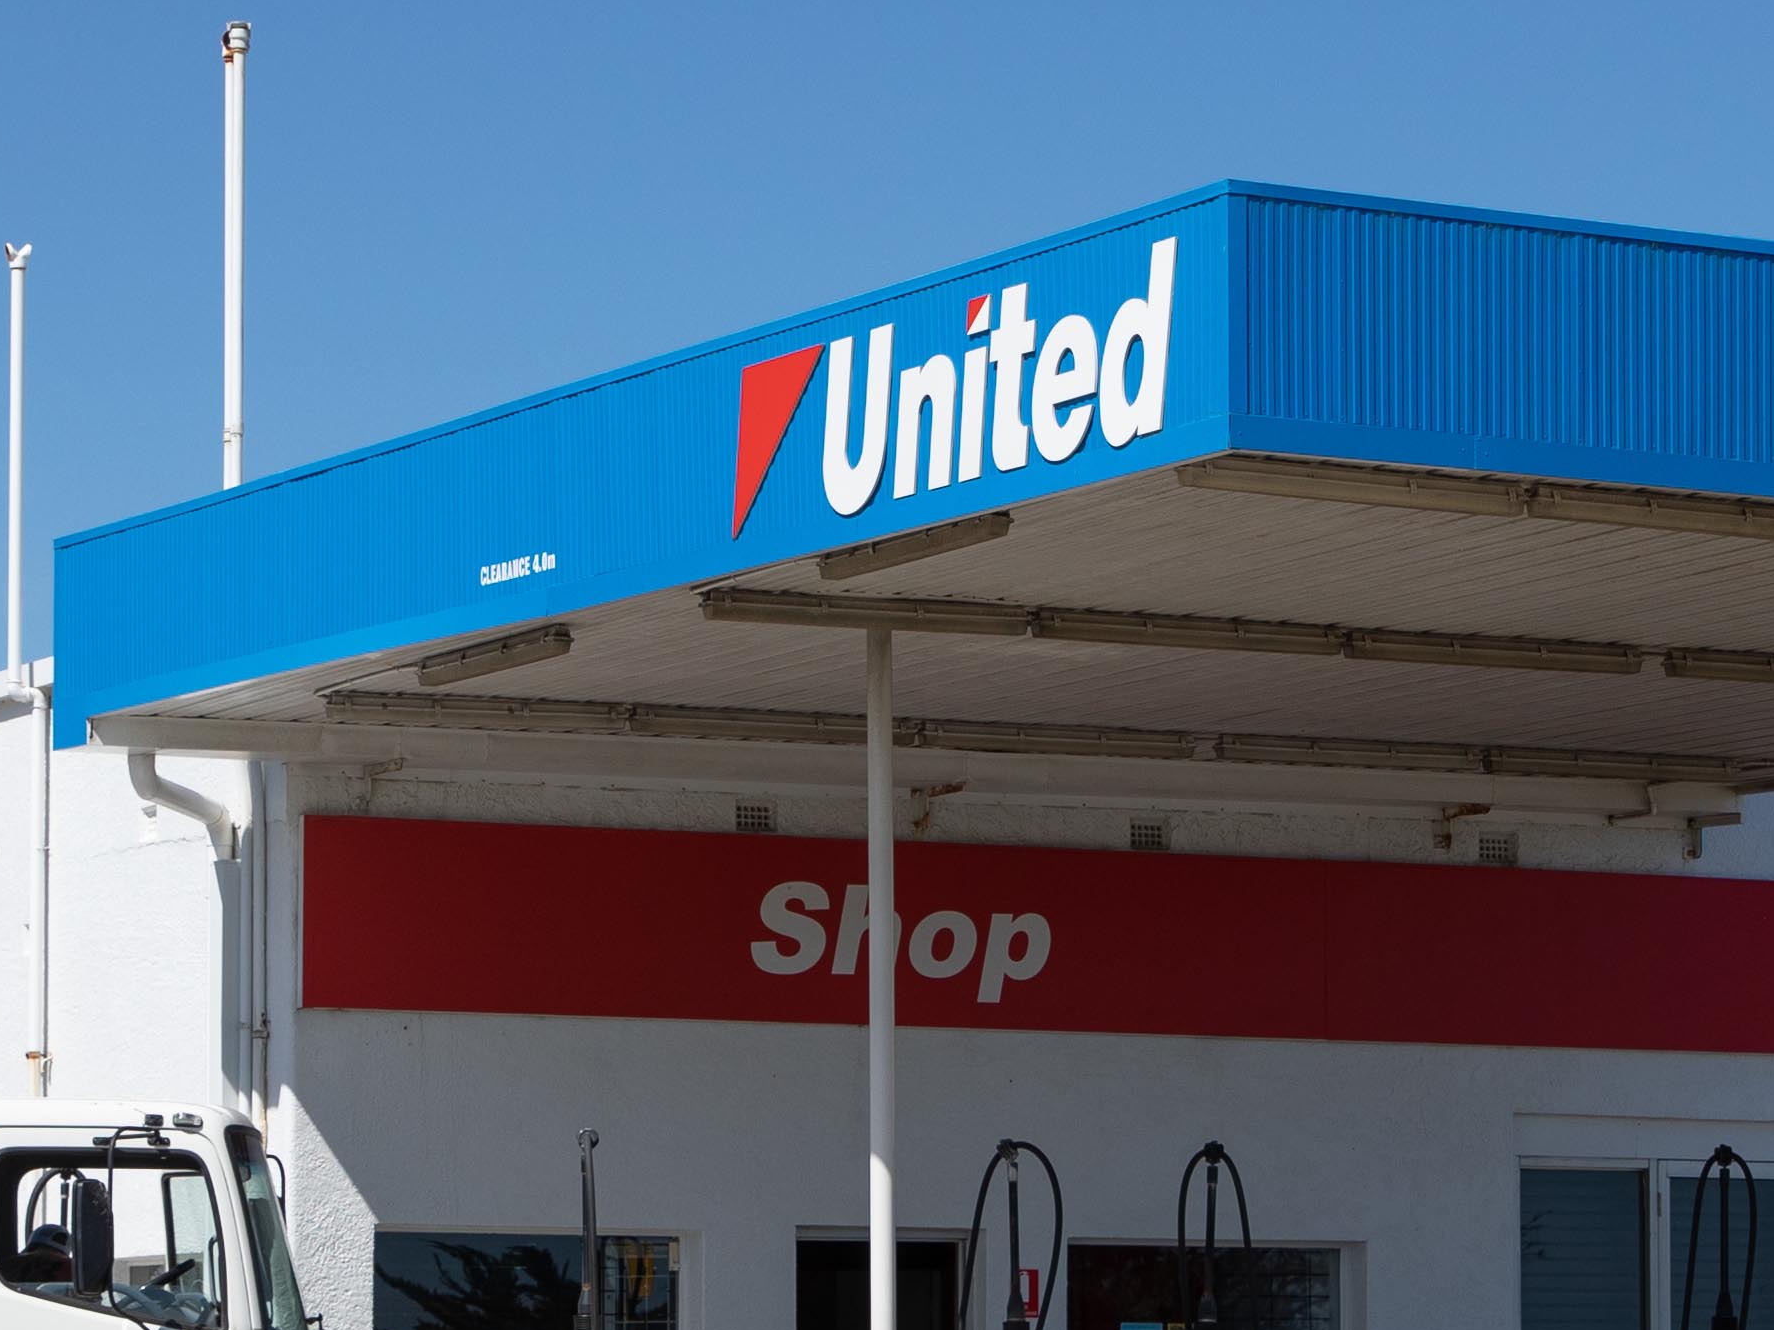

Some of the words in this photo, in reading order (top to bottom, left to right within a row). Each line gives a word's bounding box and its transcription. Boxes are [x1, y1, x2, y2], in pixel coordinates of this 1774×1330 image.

[823, 237, 1178, 516] United
[480, 556, 530, 586] CLEARANCE
[750, 881, 1052, 1003] Shop
